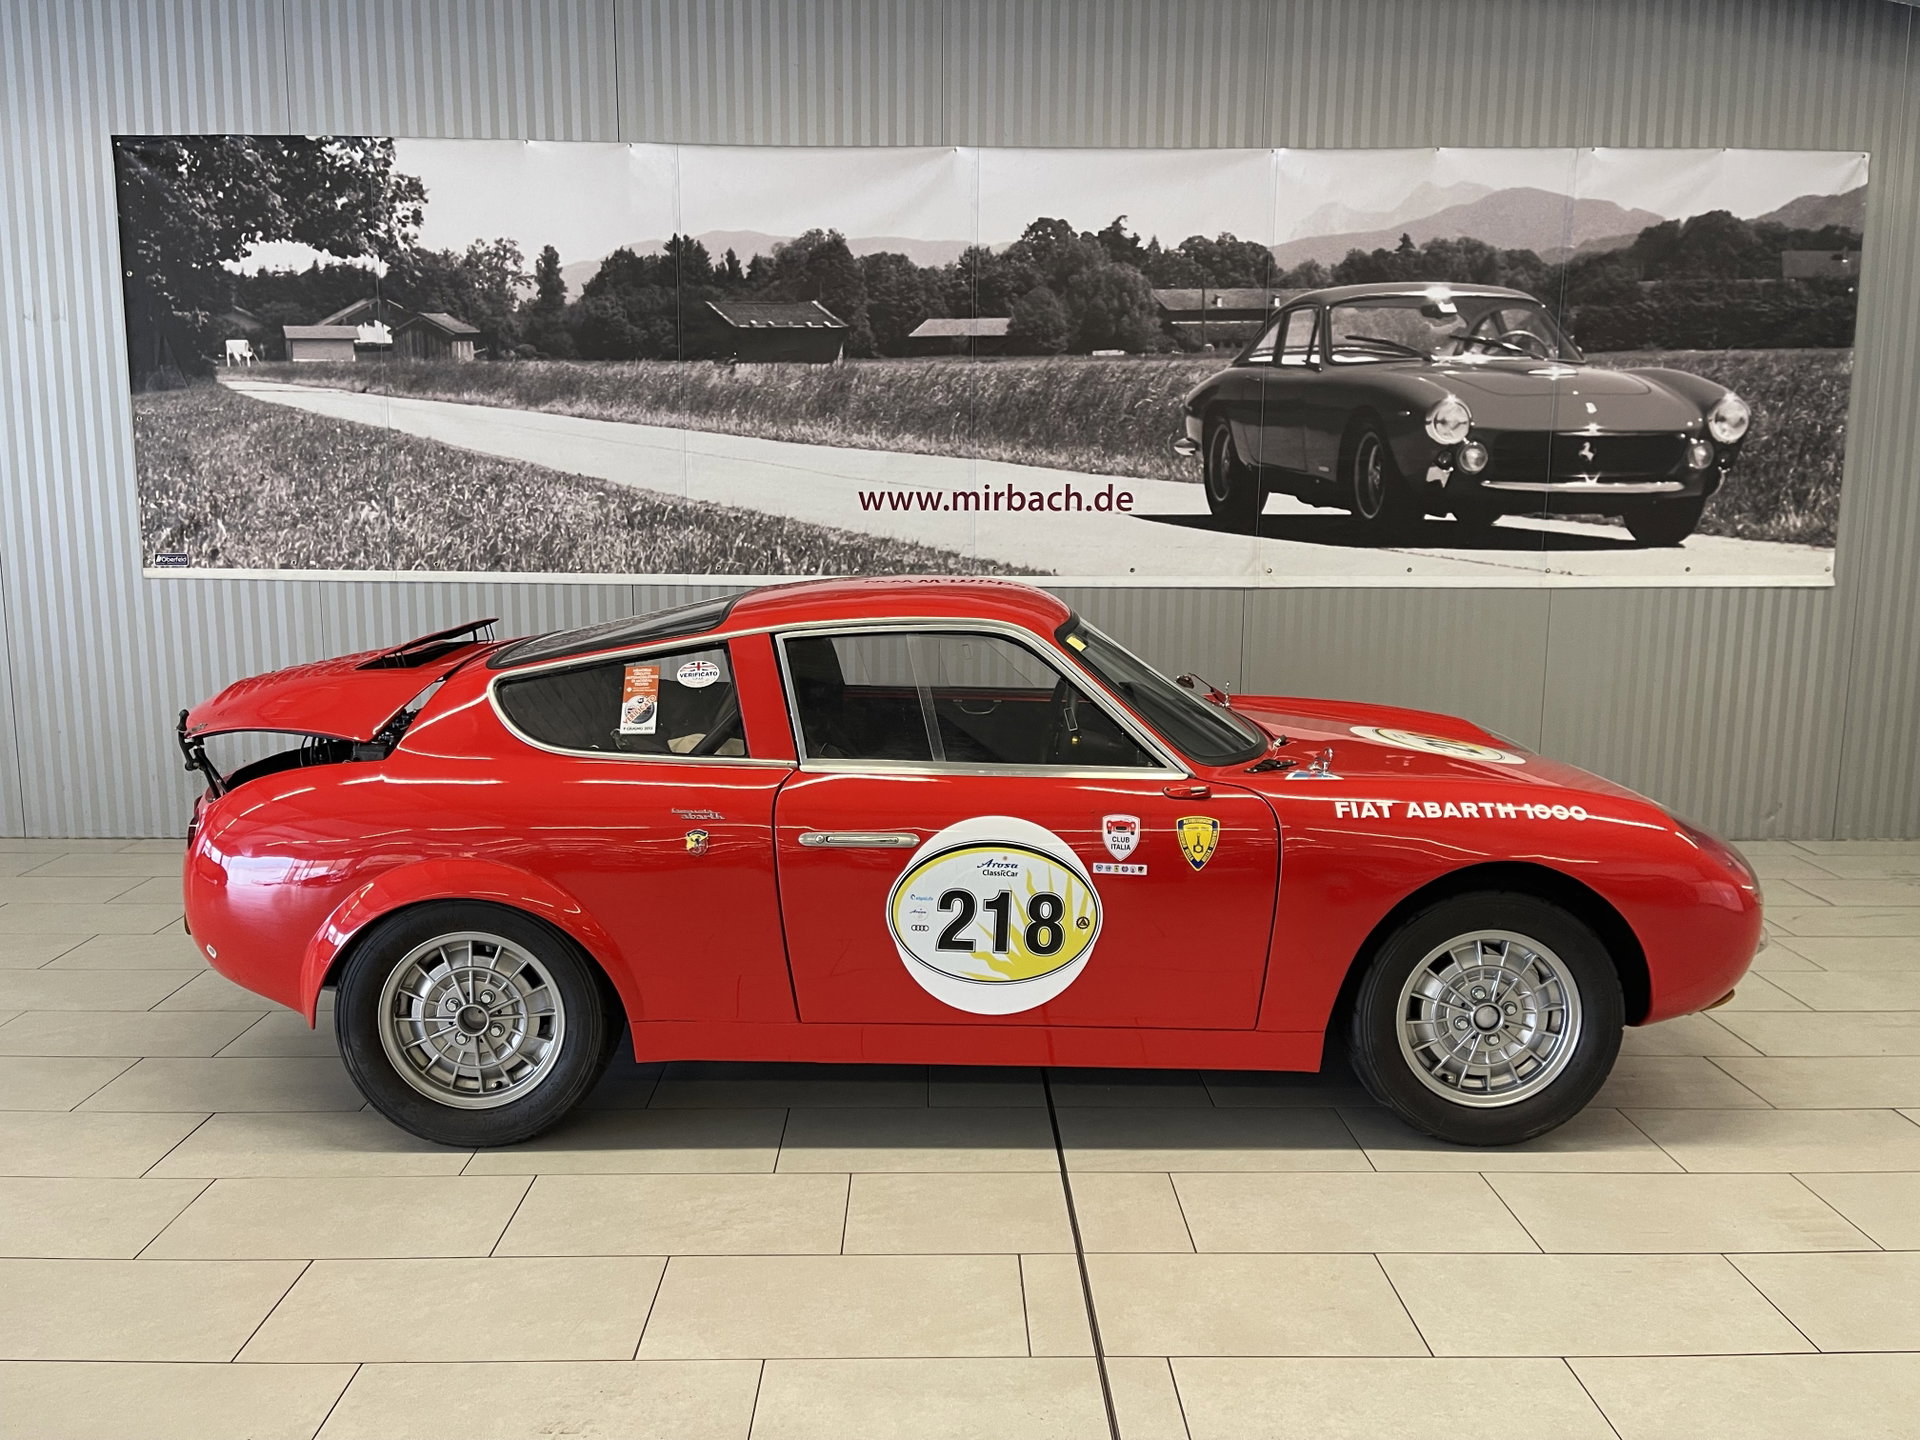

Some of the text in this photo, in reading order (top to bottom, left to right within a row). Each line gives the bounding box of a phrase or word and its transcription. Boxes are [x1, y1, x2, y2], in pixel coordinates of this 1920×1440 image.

[858, 484, 1134, 512] www.mirbach.de
[622, 694, 656, 724] VERIFICATO
[1334, 801, 1588, 821] FIAT ABARTH 1000
[977, 858, 1018, 869] Arosa
[982, 869, 1018, 877] ClassicCar
[935, 888, 1066, 957] 218
